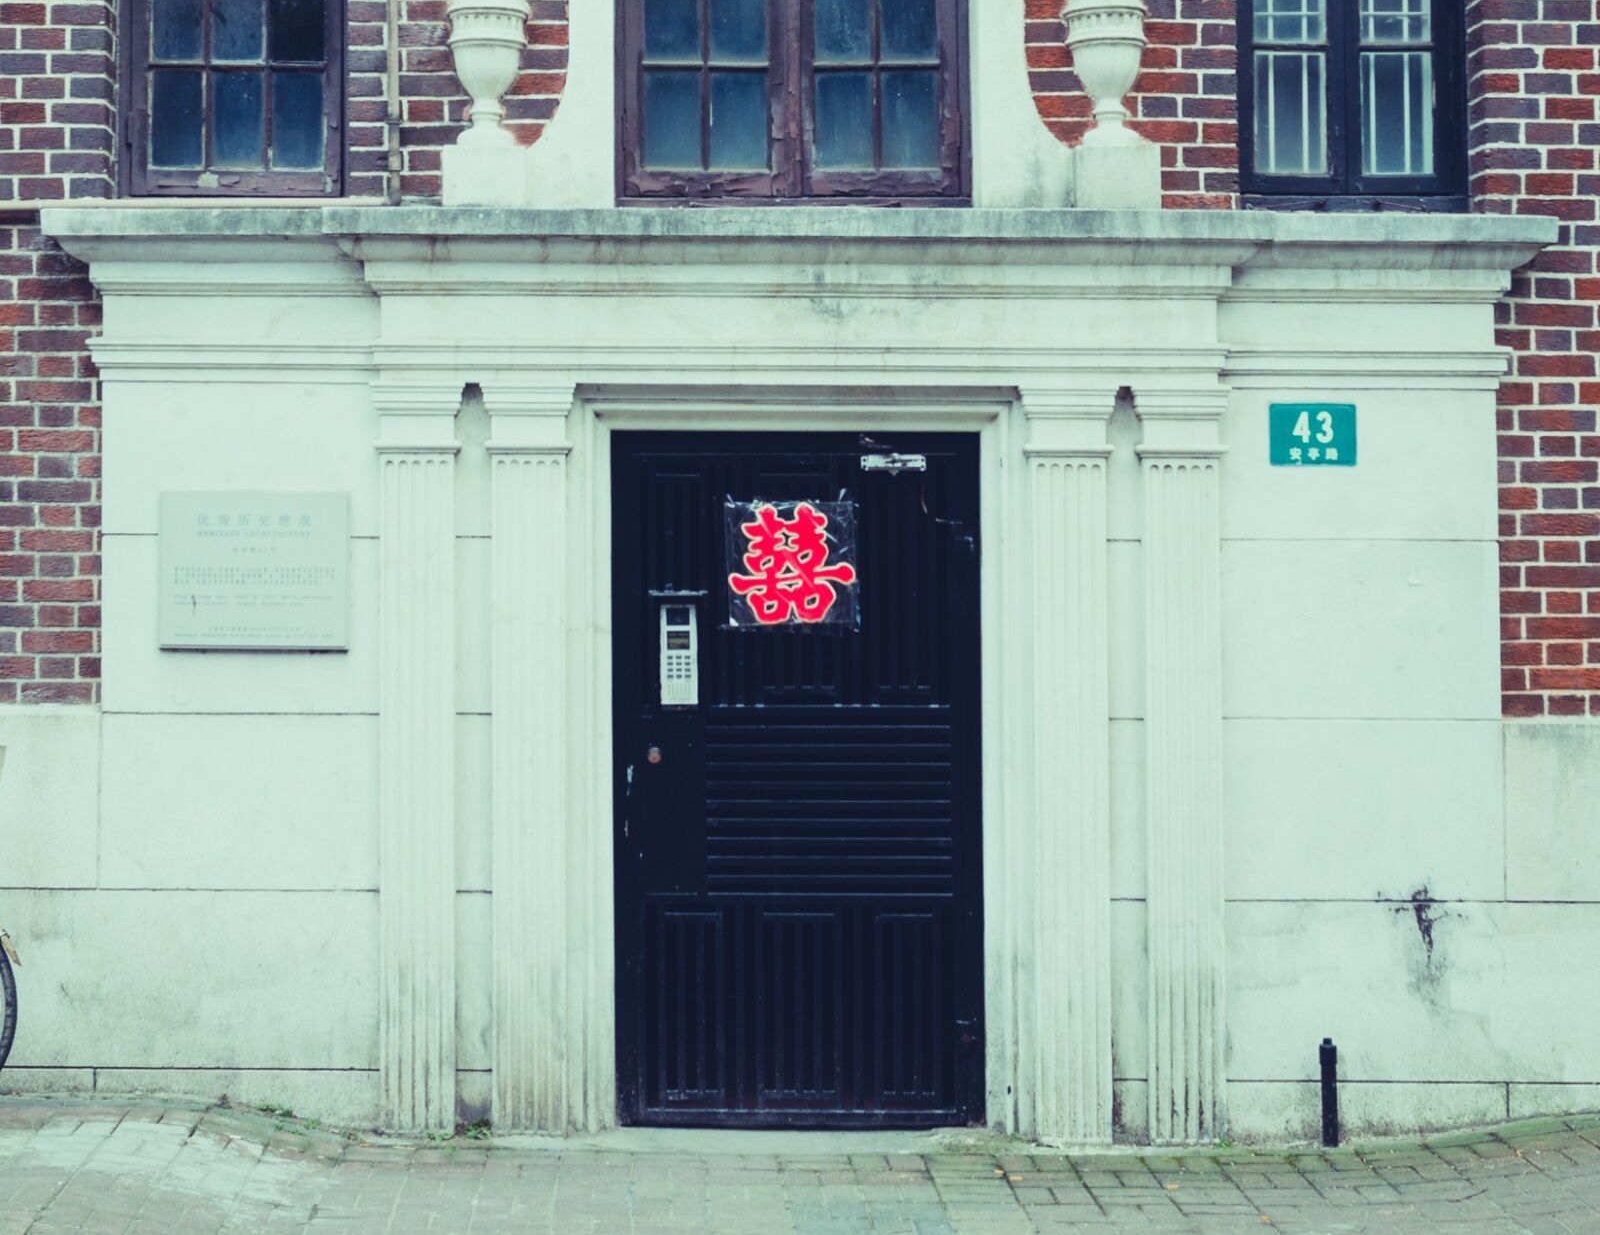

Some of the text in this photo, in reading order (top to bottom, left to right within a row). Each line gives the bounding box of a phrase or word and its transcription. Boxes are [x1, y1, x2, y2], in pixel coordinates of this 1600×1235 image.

[1292, 411, 1333, 443] 43
[1289, 447, 1338, 461] 安亭路
